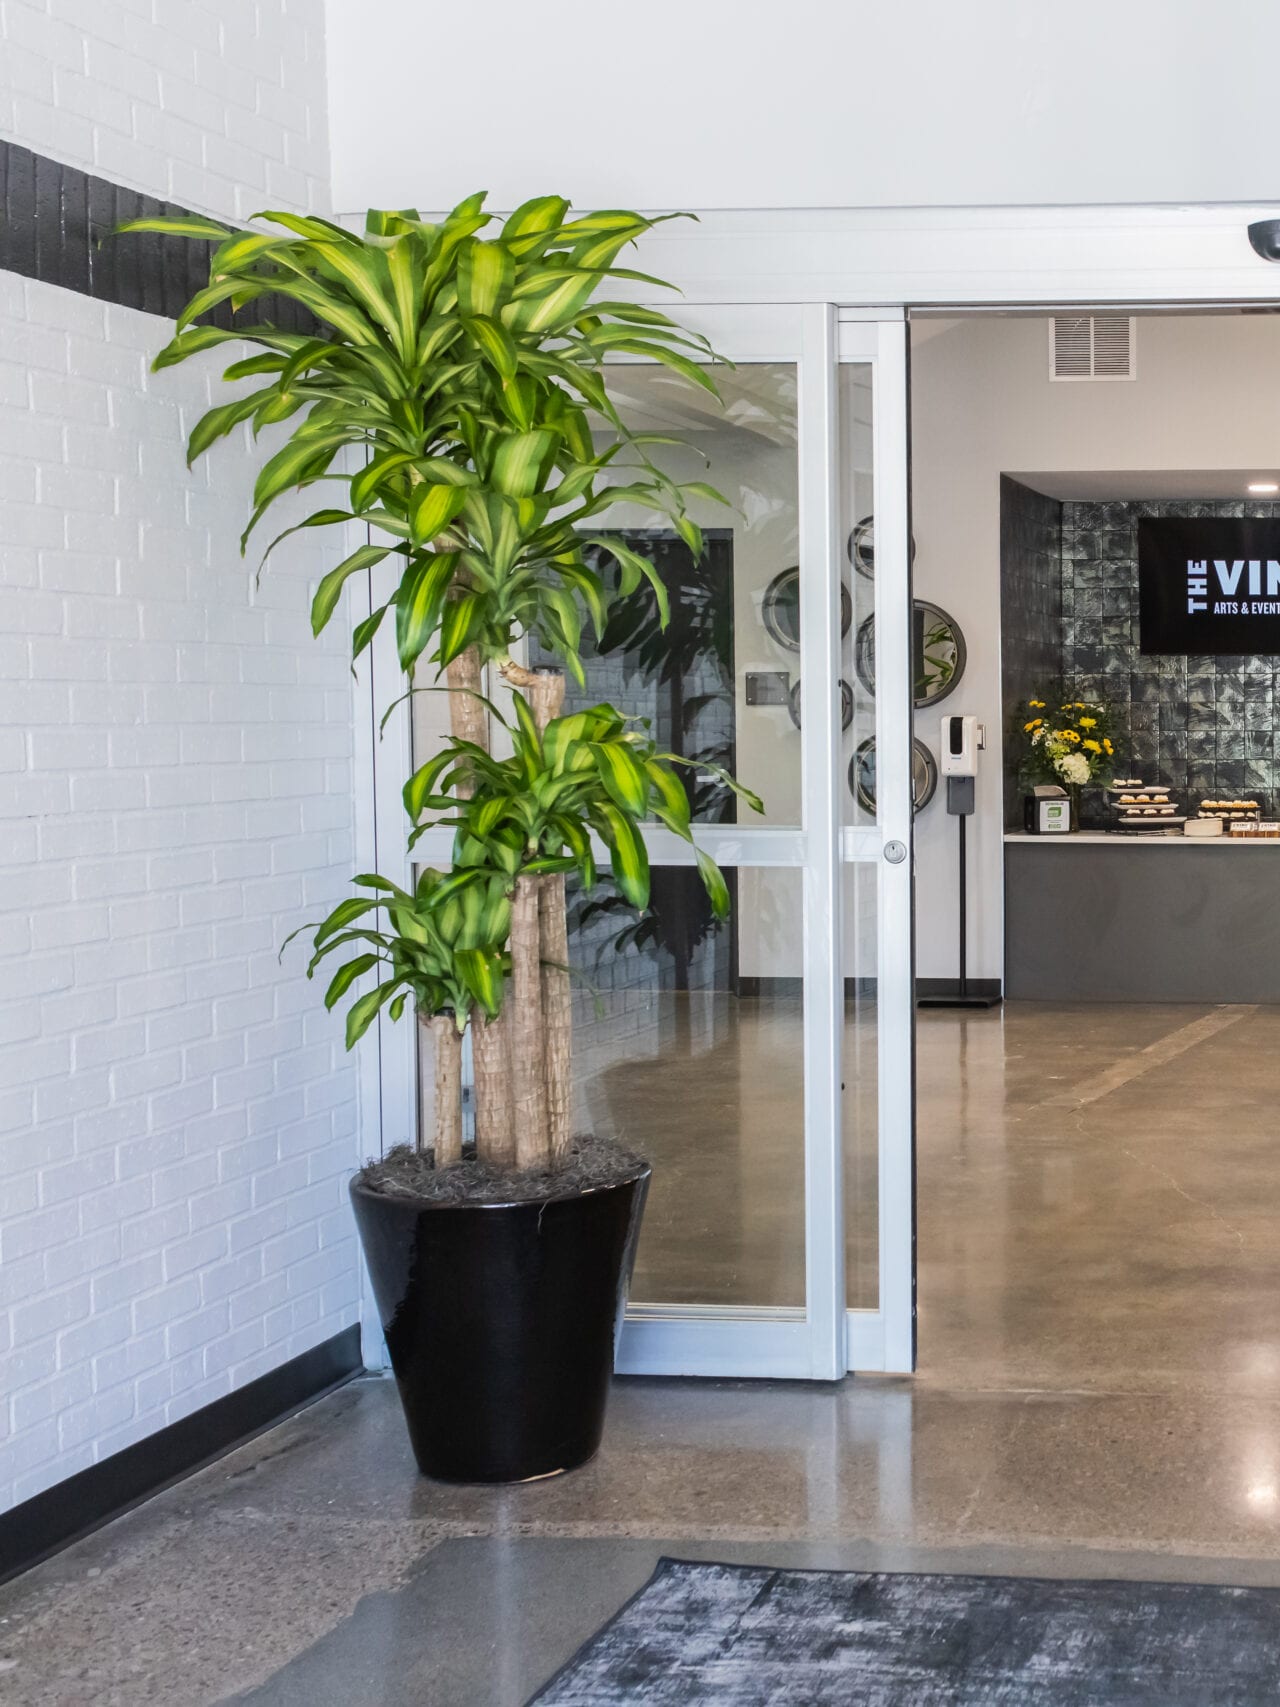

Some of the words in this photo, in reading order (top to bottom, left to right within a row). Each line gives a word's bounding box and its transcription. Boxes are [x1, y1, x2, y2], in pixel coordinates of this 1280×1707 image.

[1187, 560, 1207, 614] THE
[1213, 602, 1238, 615] ARTS
[1241, 602, 1249, 615] &
